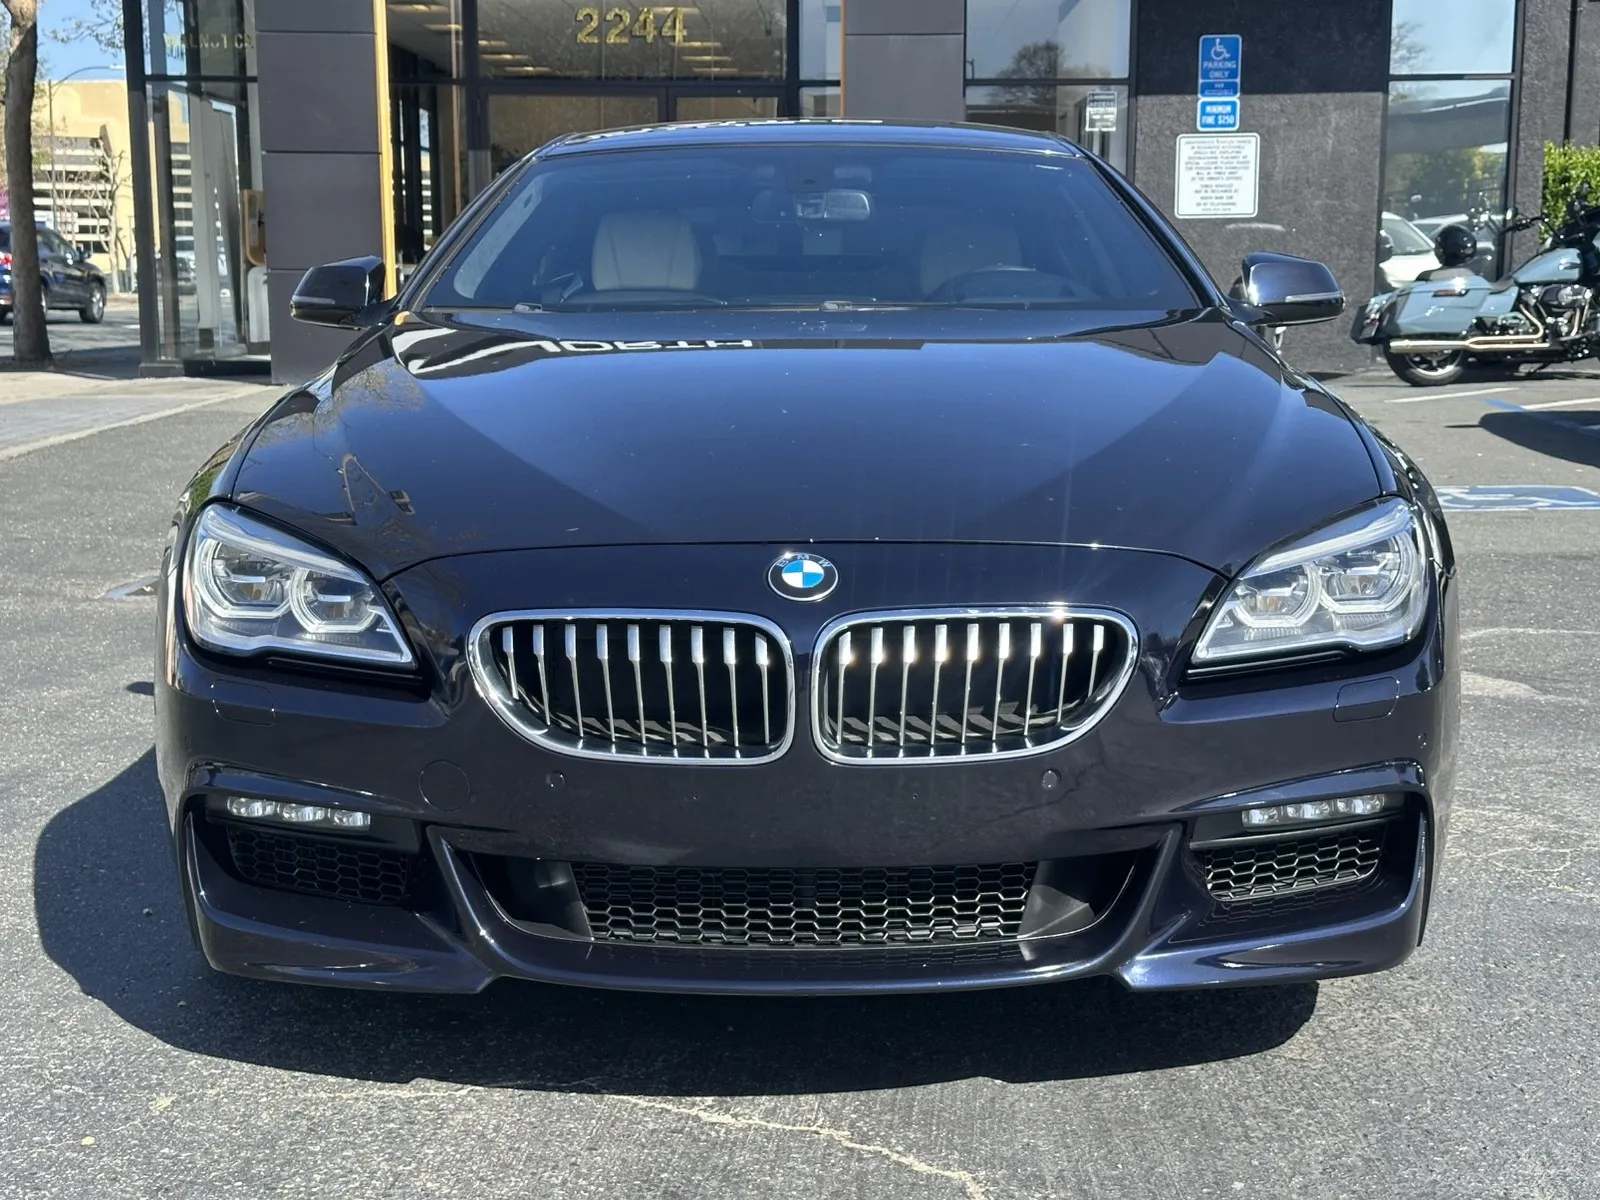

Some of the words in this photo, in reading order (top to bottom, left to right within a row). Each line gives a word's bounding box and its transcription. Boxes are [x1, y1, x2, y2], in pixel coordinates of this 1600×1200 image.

[576, 6, 688, 44] 2244
[1203, 60, 1237, 69] PARKING
[1209, 70, 1230, 79] ONLY
[776, 553, 832, 568] BMW
